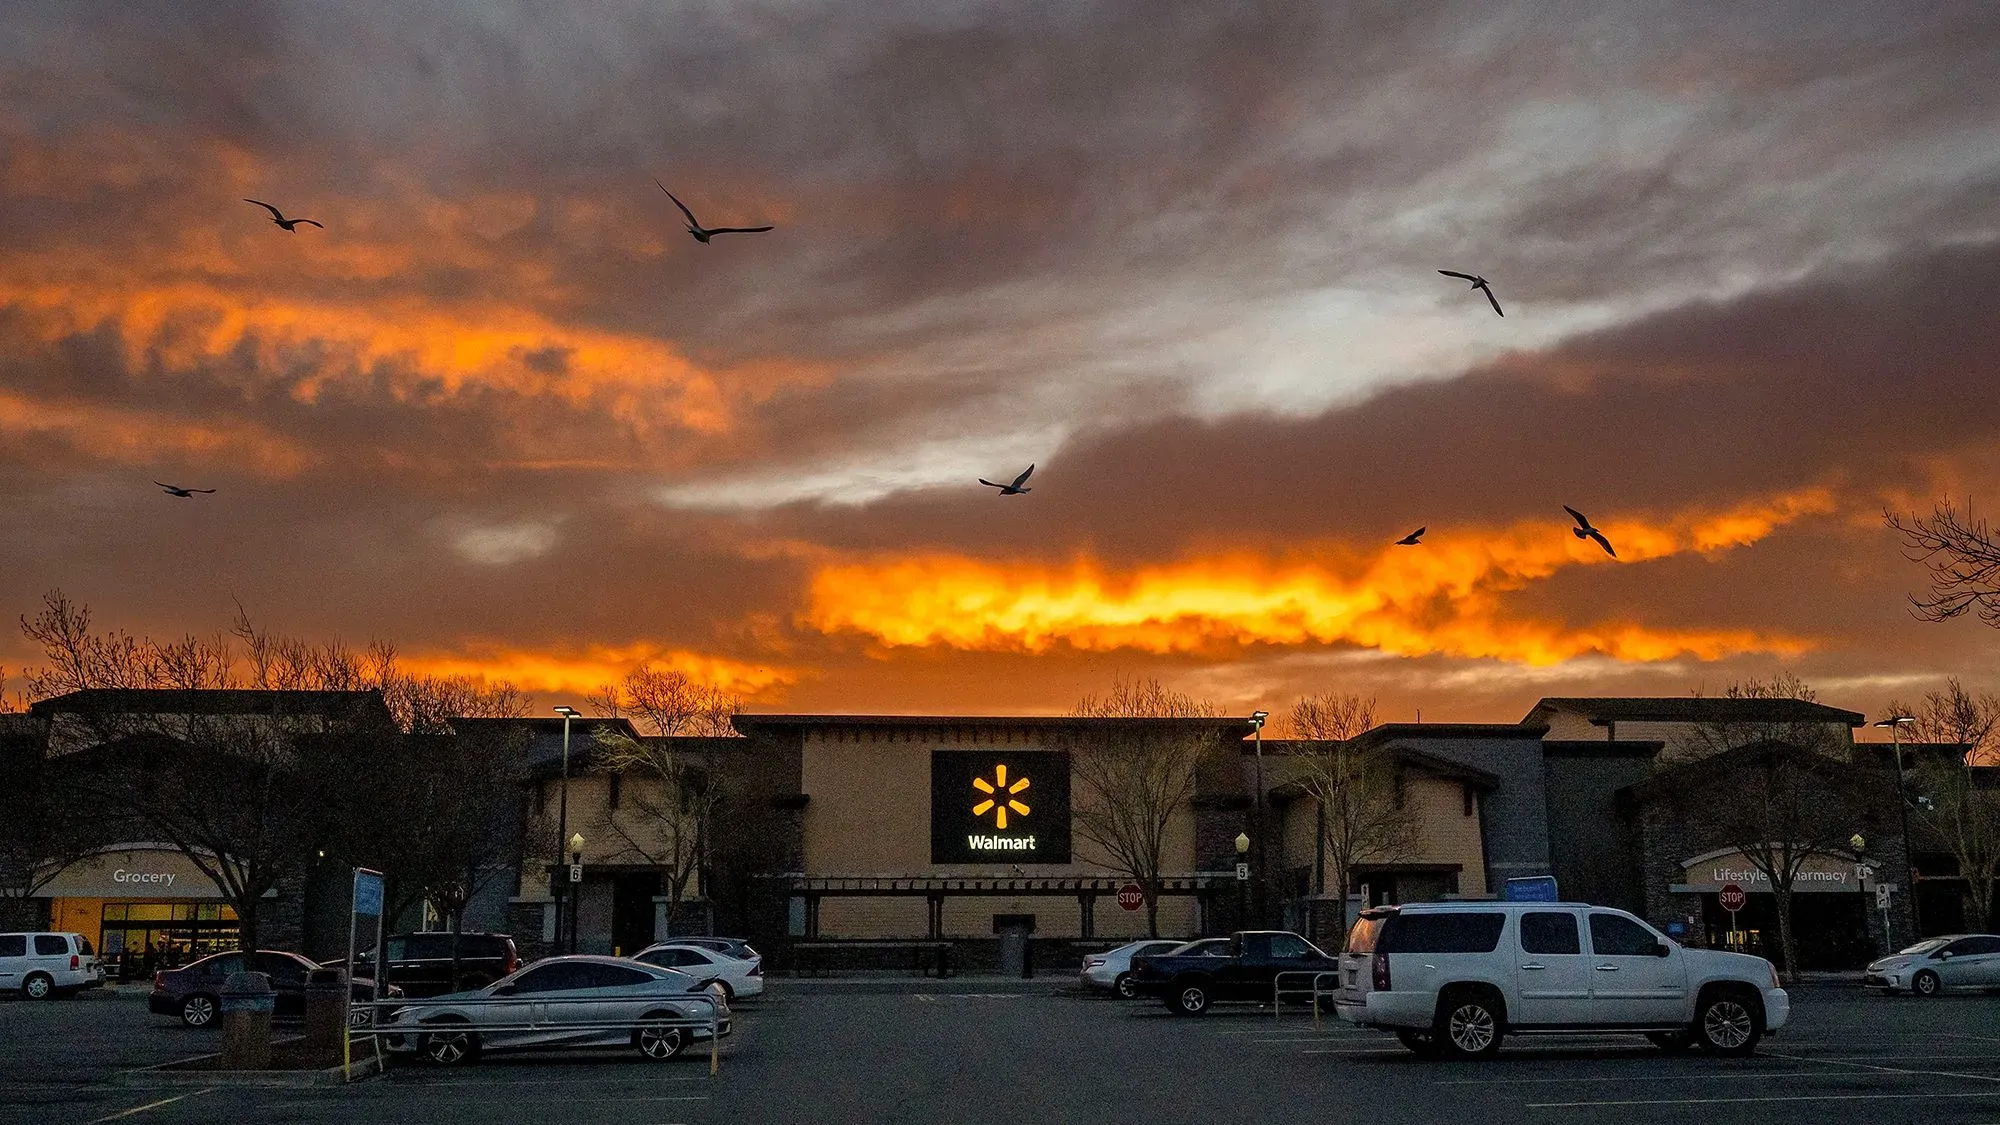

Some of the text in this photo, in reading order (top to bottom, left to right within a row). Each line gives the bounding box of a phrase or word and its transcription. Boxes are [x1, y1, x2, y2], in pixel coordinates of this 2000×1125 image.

[968, 835, 1036, 850] Walmart
[113, 869, 176, 887] Grocery
[573, 869, 579, 880] 6
[1240, 867, 1246, 878] 5
[1713, 868, 1768, 884] Lifestyle
[1788, 868, 1847, 884] harmacy
[1119, 892, 1143, 904] STOP
[1721, 892, 1743, 903] STOP
